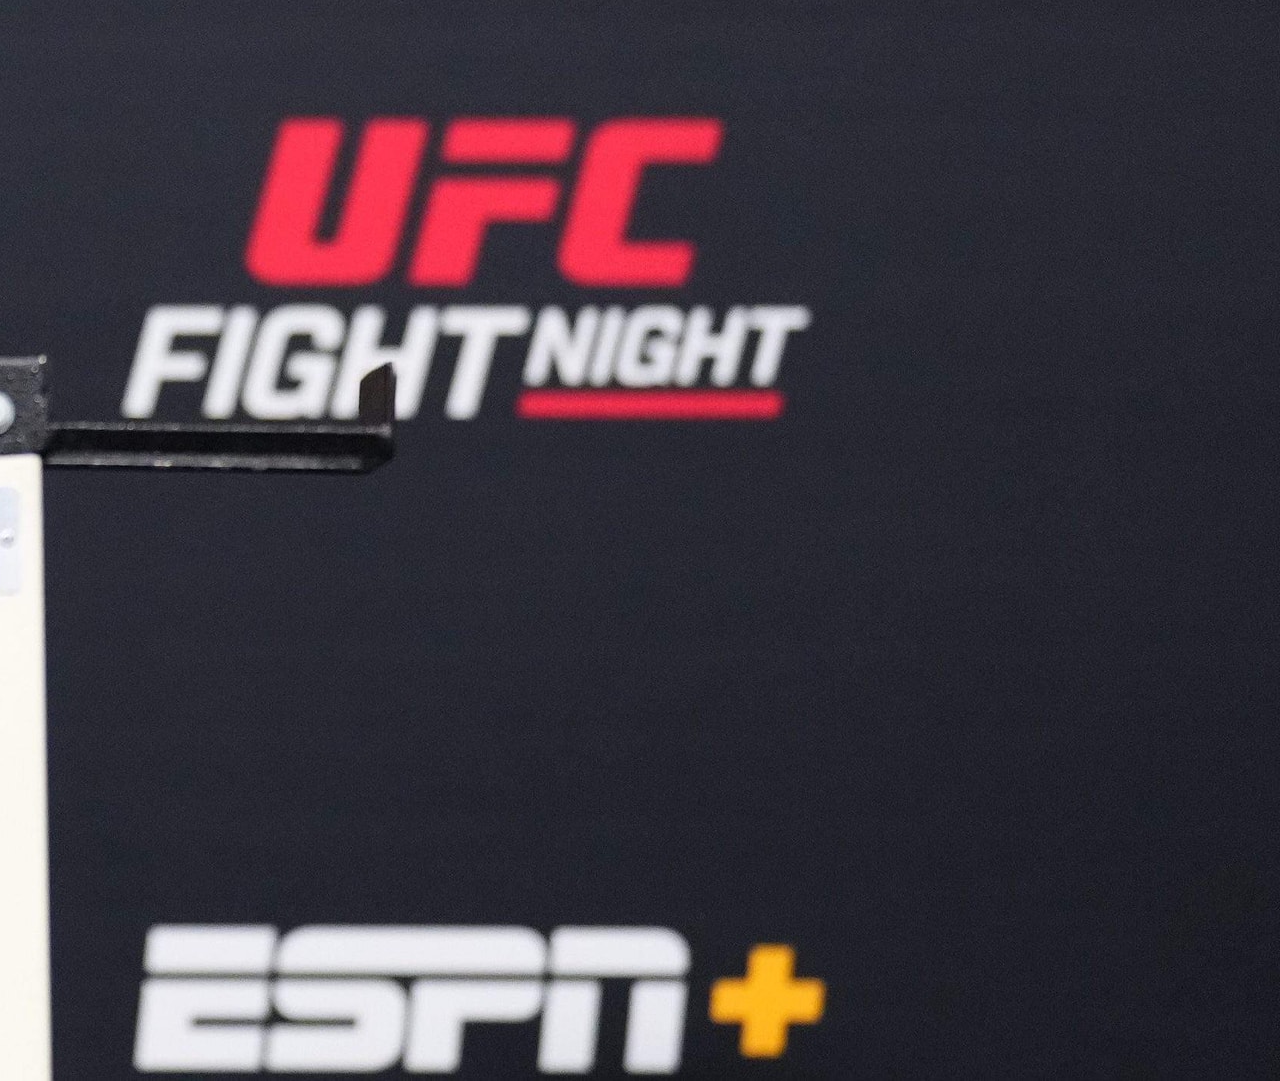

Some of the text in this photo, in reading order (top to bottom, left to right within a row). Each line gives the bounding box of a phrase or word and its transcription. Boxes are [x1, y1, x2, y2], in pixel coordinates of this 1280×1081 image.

[244, 117, 723, 286] UFC
[121, 304, 811, 419] FIGHT NIGHT
